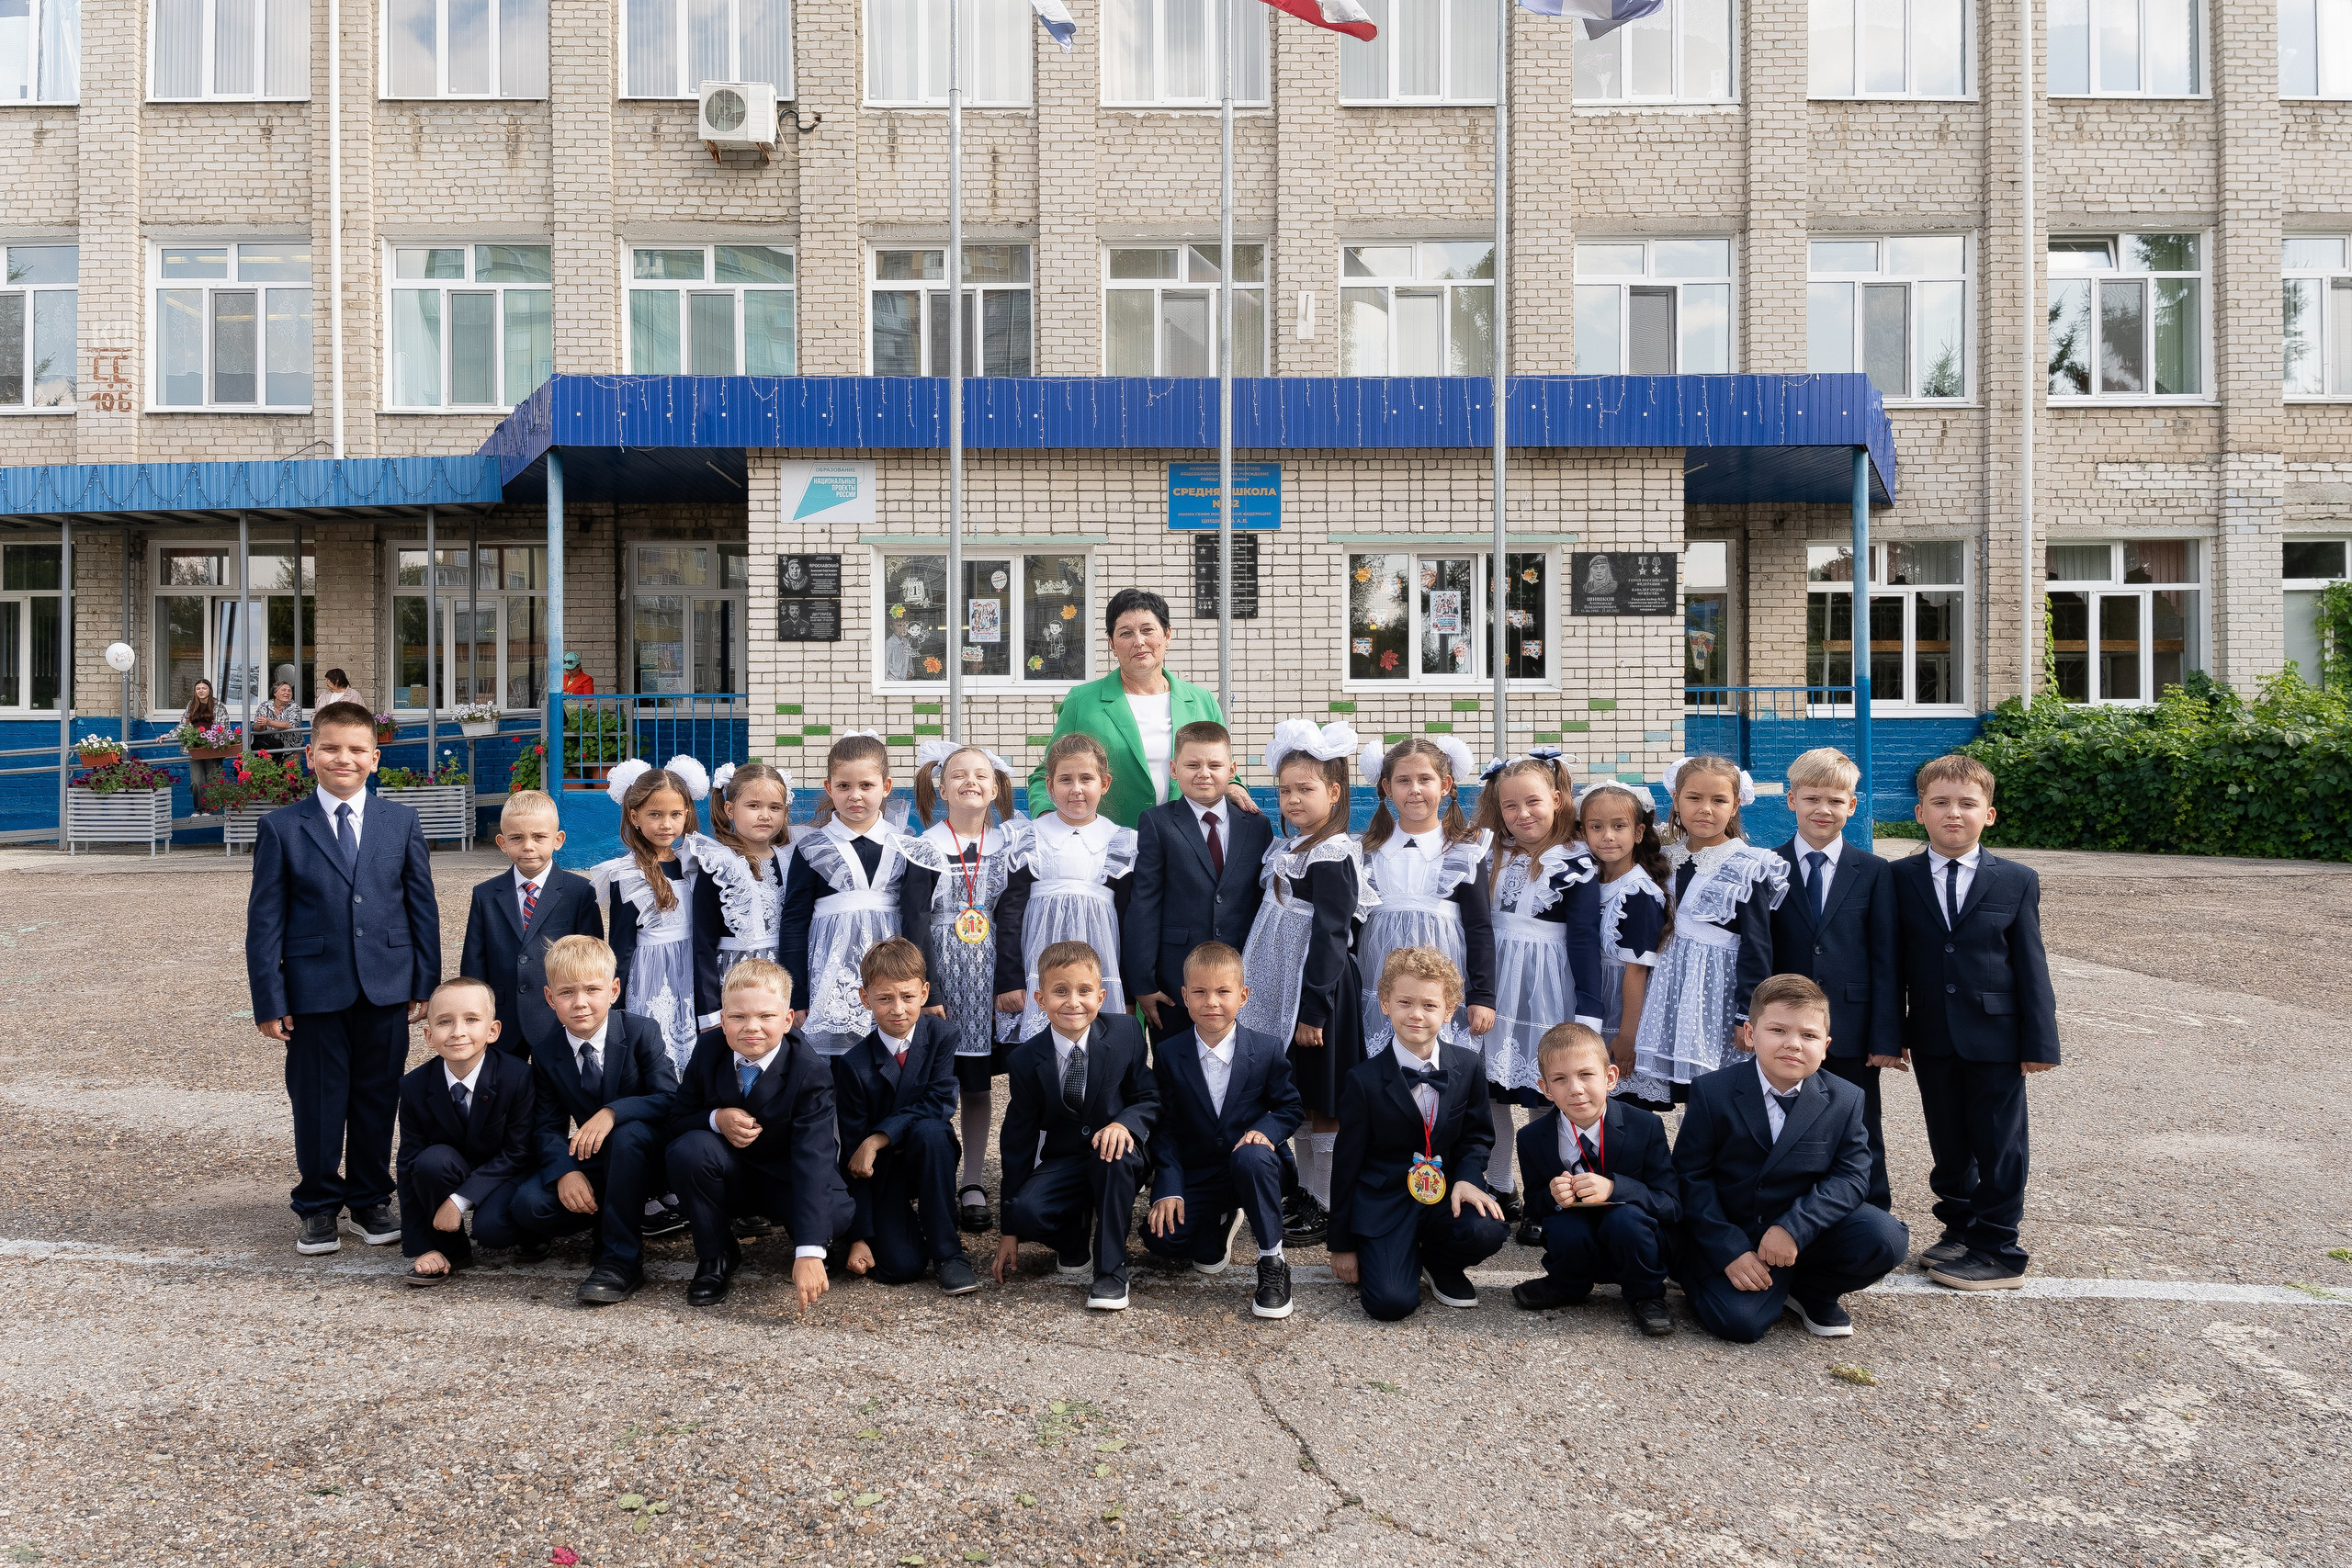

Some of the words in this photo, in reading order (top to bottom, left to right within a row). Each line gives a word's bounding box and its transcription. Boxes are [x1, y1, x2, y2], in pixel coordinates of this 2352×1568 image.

[1172, 487, 1221, 497] СРЕДНЯ
[1232, 487, 1277, 496] ШКОЛА
[968, 919, 975, 932] 1
[1423, 1176, 1430, 1191] 1
